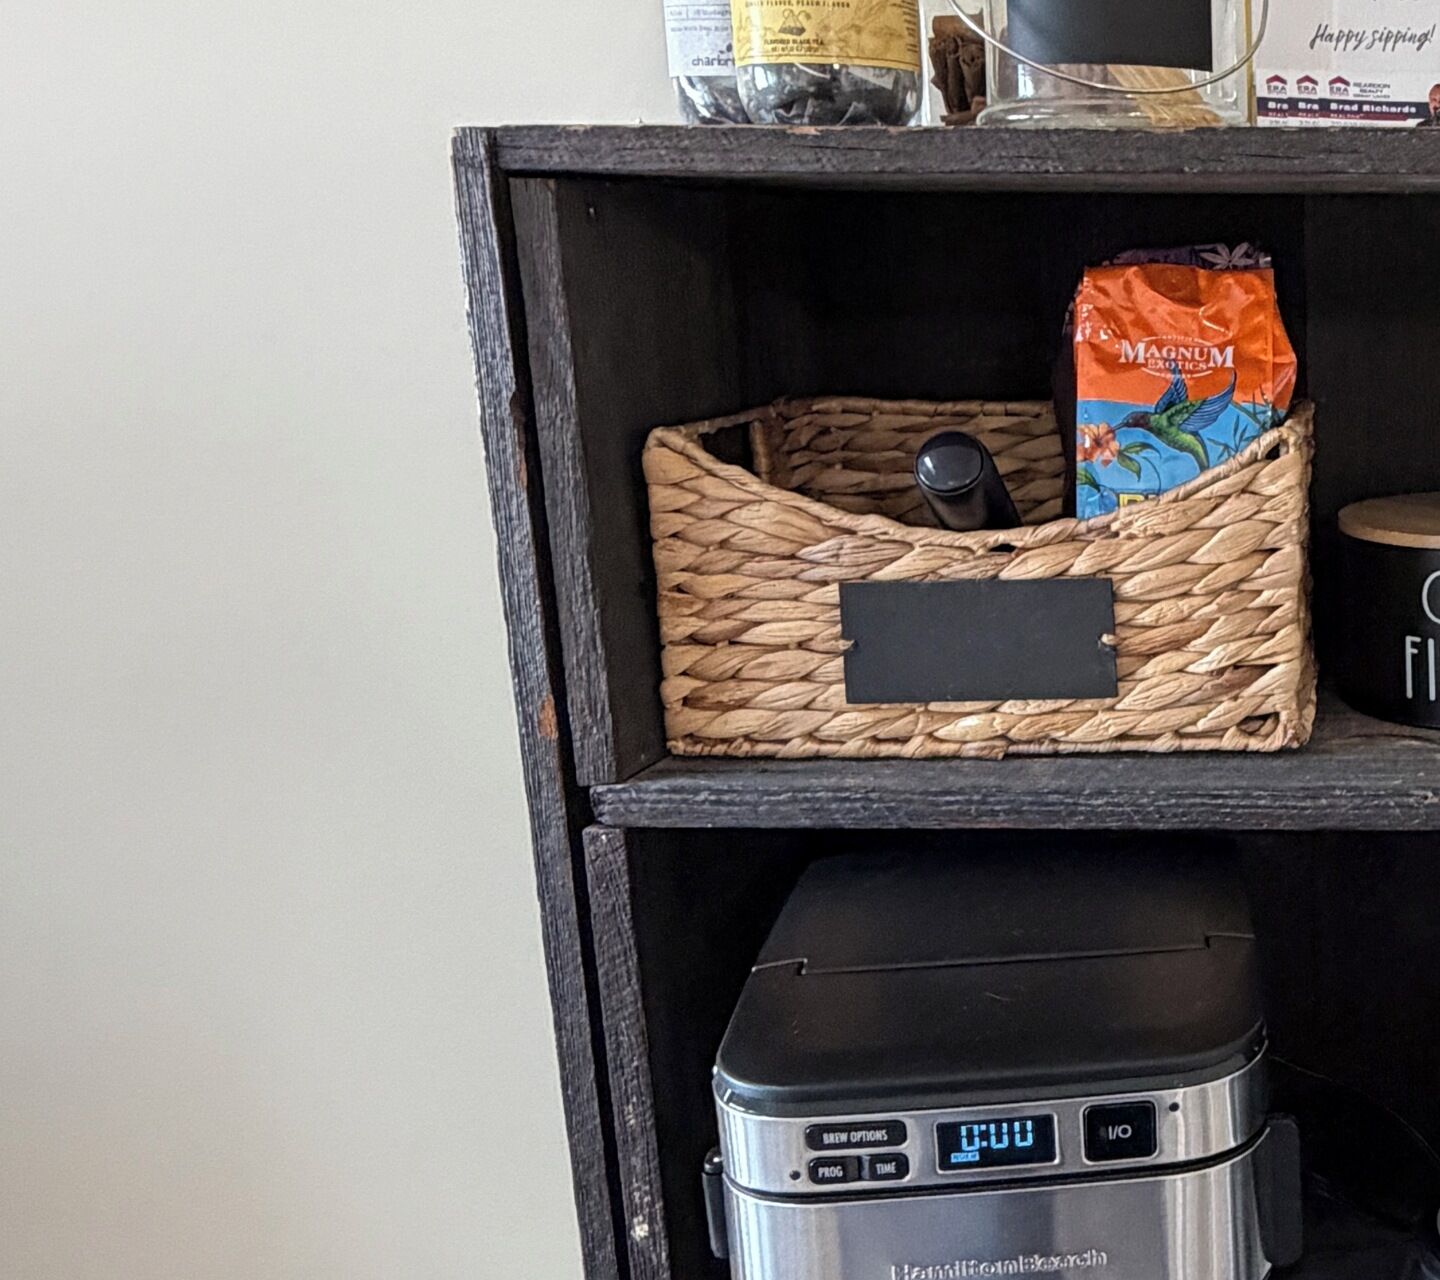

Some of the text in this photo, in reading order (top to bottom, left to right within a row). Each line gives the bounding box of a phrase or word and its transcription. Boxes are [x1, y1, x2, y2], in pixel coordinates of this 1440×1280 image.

[1309, 23, 1437, 52] Happy sipping!
[1330, 102, 1416, 113] Brad Richards
[1118, 339, 1235, 368] MAGNUM
[1147, 359, 1208, 371] EXOTICS
[823, 1130, 888, 1144] BREW OPTIONS
[818, 1162, 897, 1179] PROG TIME
